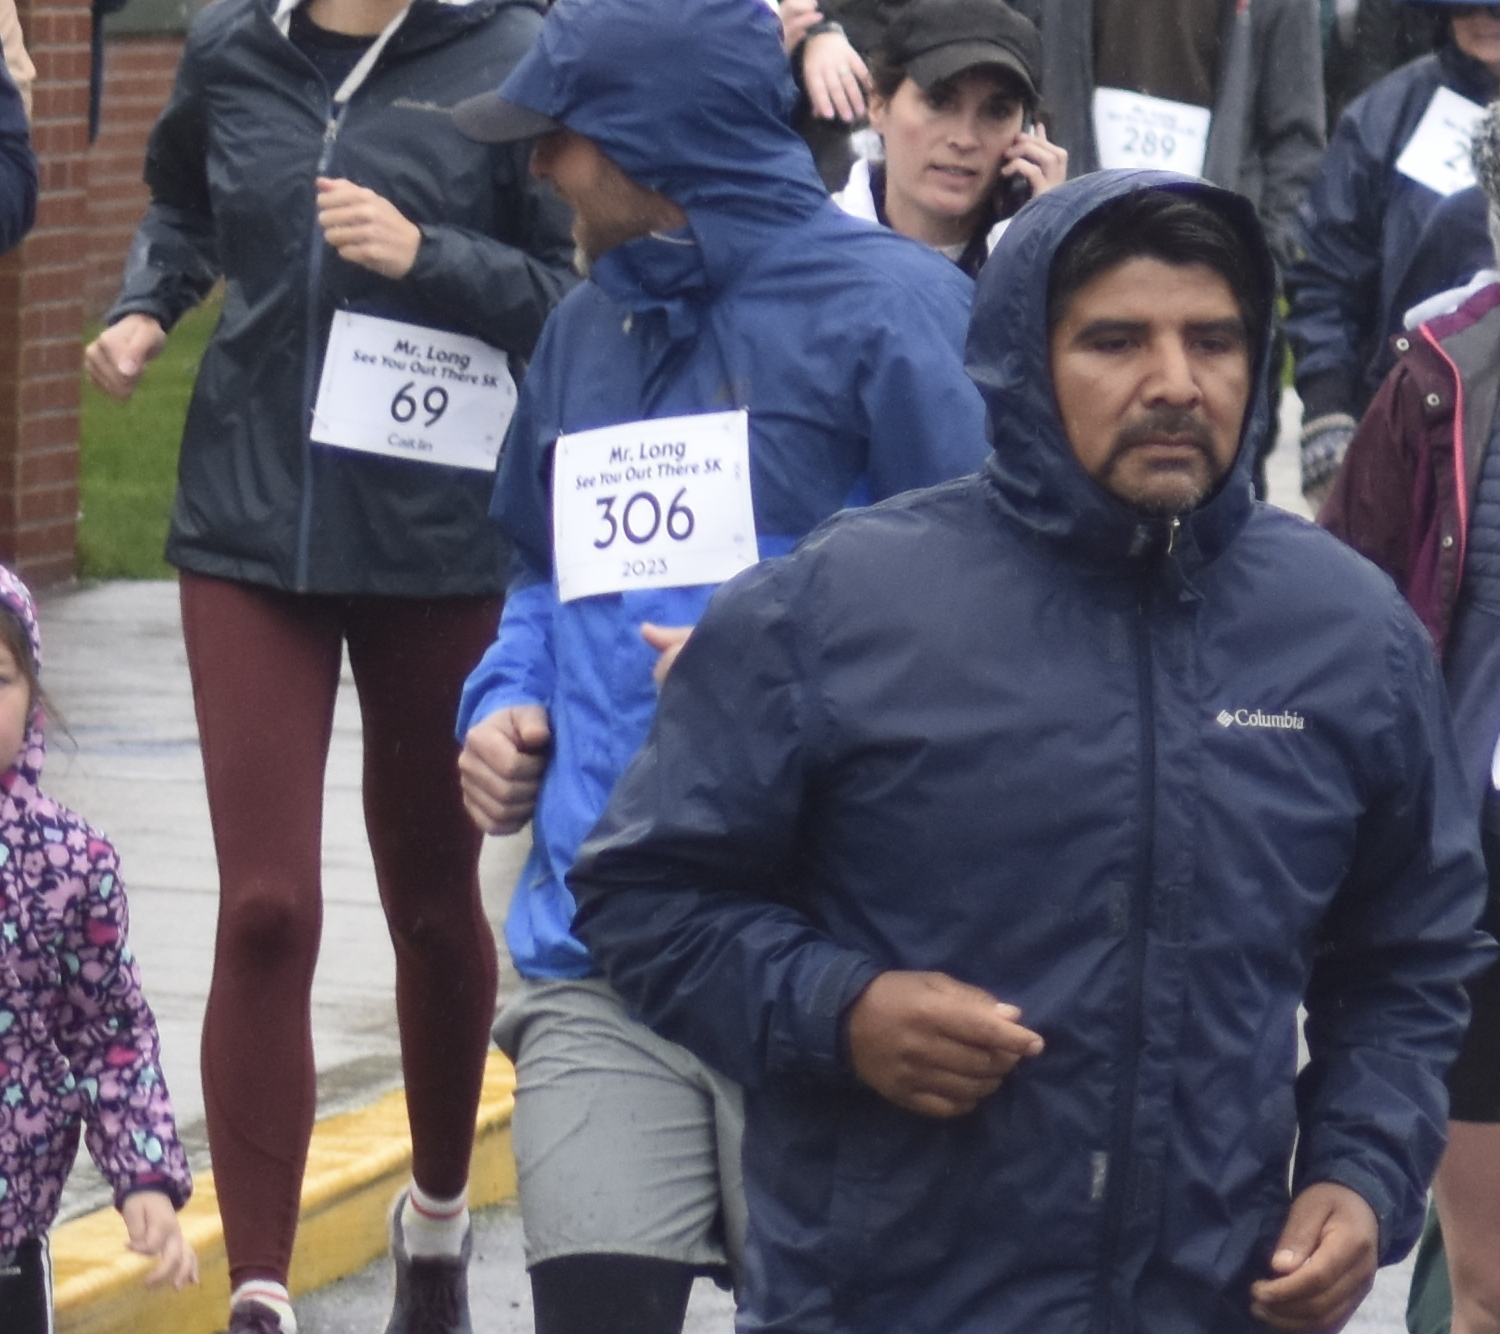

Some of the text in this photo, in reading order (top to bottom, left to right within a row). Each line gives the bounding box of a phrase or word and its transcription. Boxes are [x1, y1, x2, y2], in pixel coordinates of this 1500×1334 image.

[1123, 127, 1176, 159] 289
[353, 349, 378, 365] See
[381, 354, 406, 371] You
[409, 360, 437, 377] Out
[441, 365, 479, 385] There
[394, 338, 472, 370] Mr. Long
[390, 380, 449, 428] 69
[609, 441, 687, 464] Mr. Long
[575, 475, 597, 490] See
[600, 471, 622, 485] You
[625, 466, 652, 482] Out
[657, 462, 700, 479] There
[593, 485, 695, 550] 306
[622, 558, 669, 578] 2023
[1234, 708, 1305, 730] Columbia
